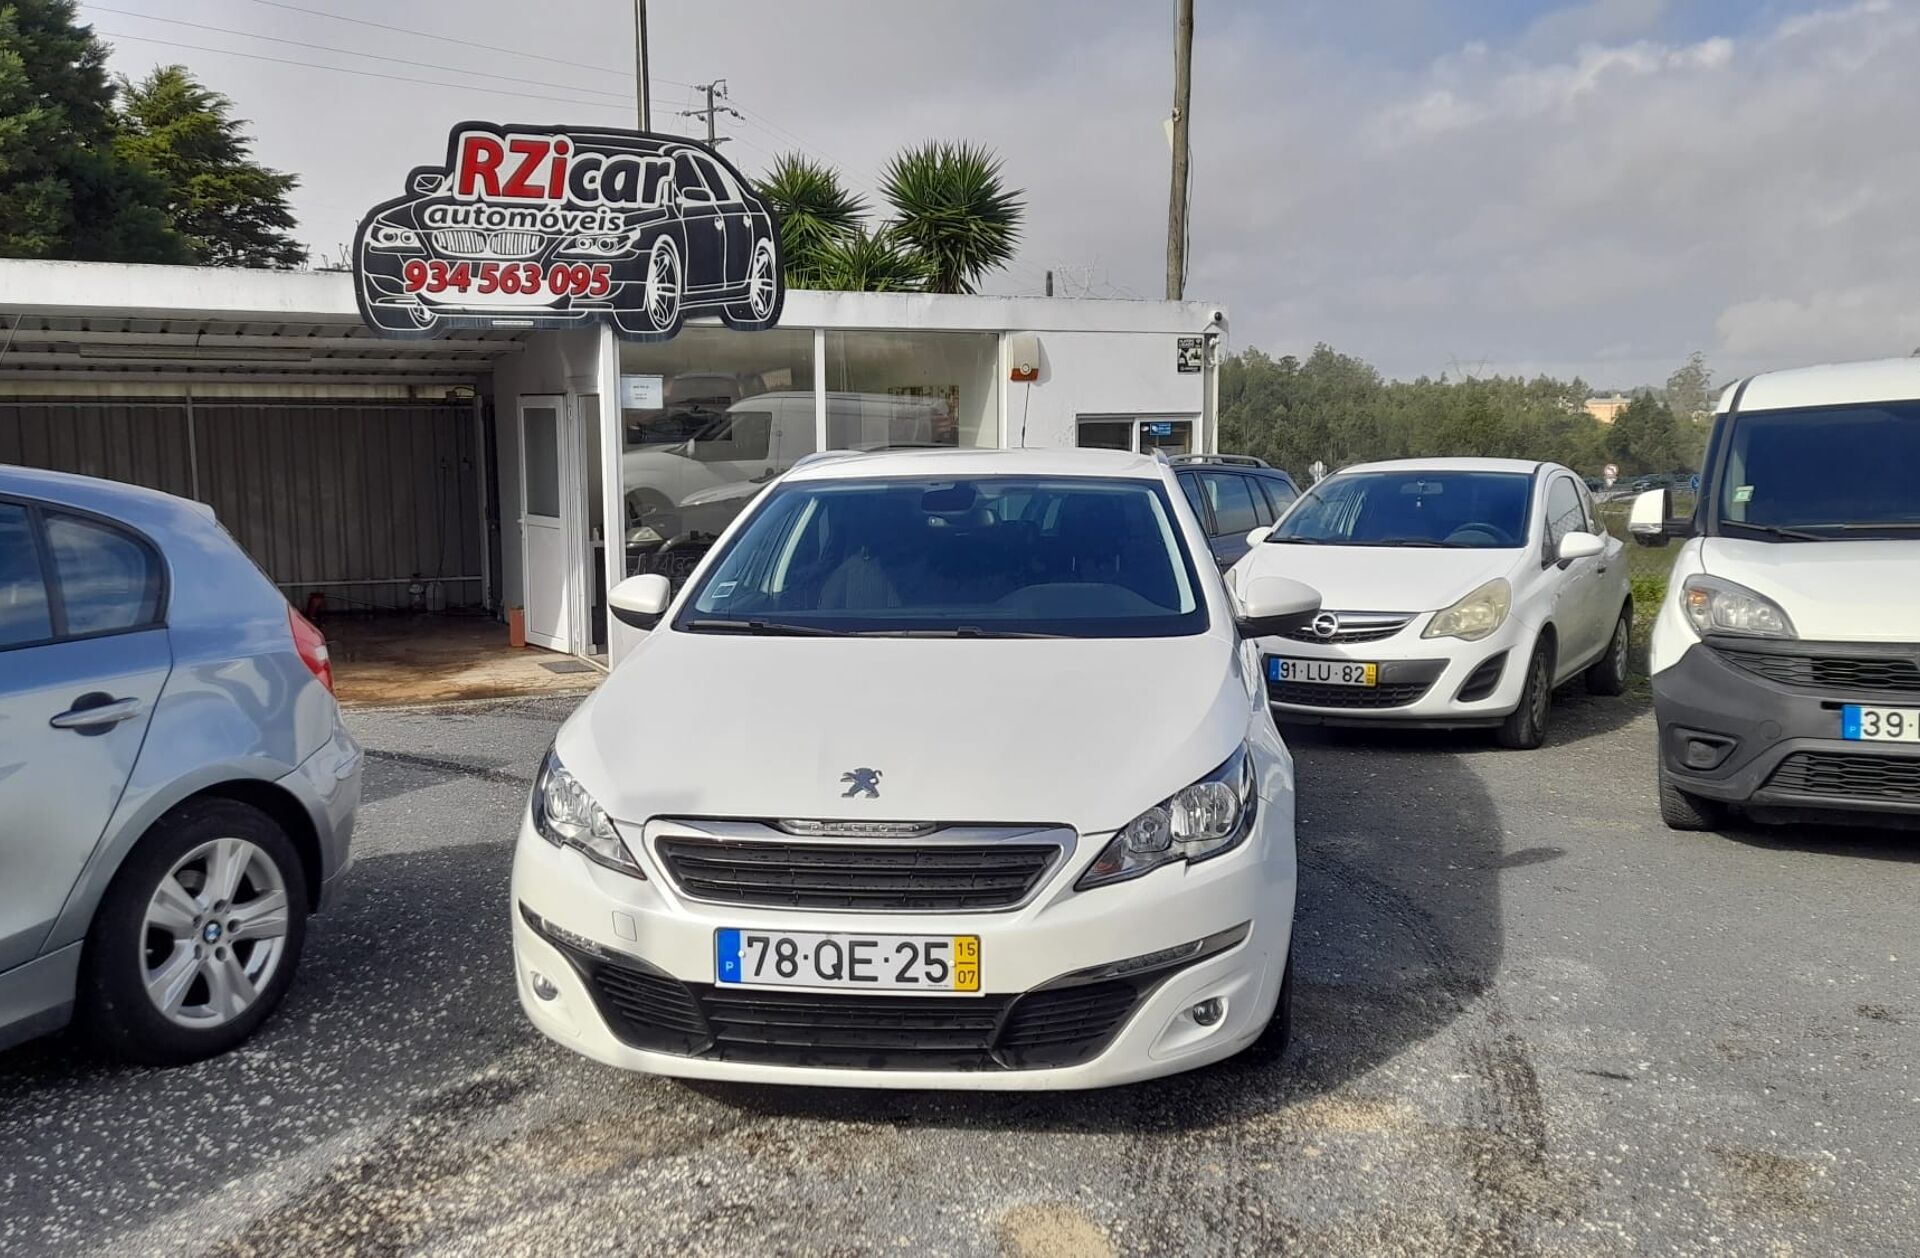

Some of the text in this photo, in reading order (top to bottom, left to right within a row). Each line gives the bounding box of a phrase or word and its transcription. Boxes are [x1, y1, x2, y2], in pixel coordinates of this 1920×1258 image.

[458, 136, 671, 203] RZicar
[428, 204, 622, 232] automóveis
[404, 260, 611, 295] 934 563 095
[1863, 711, 1920, 739] 39·
[957, 942, 976, 956] 15
[725, 961, 734, 971] P
[957, 970, 976, 984] 07
